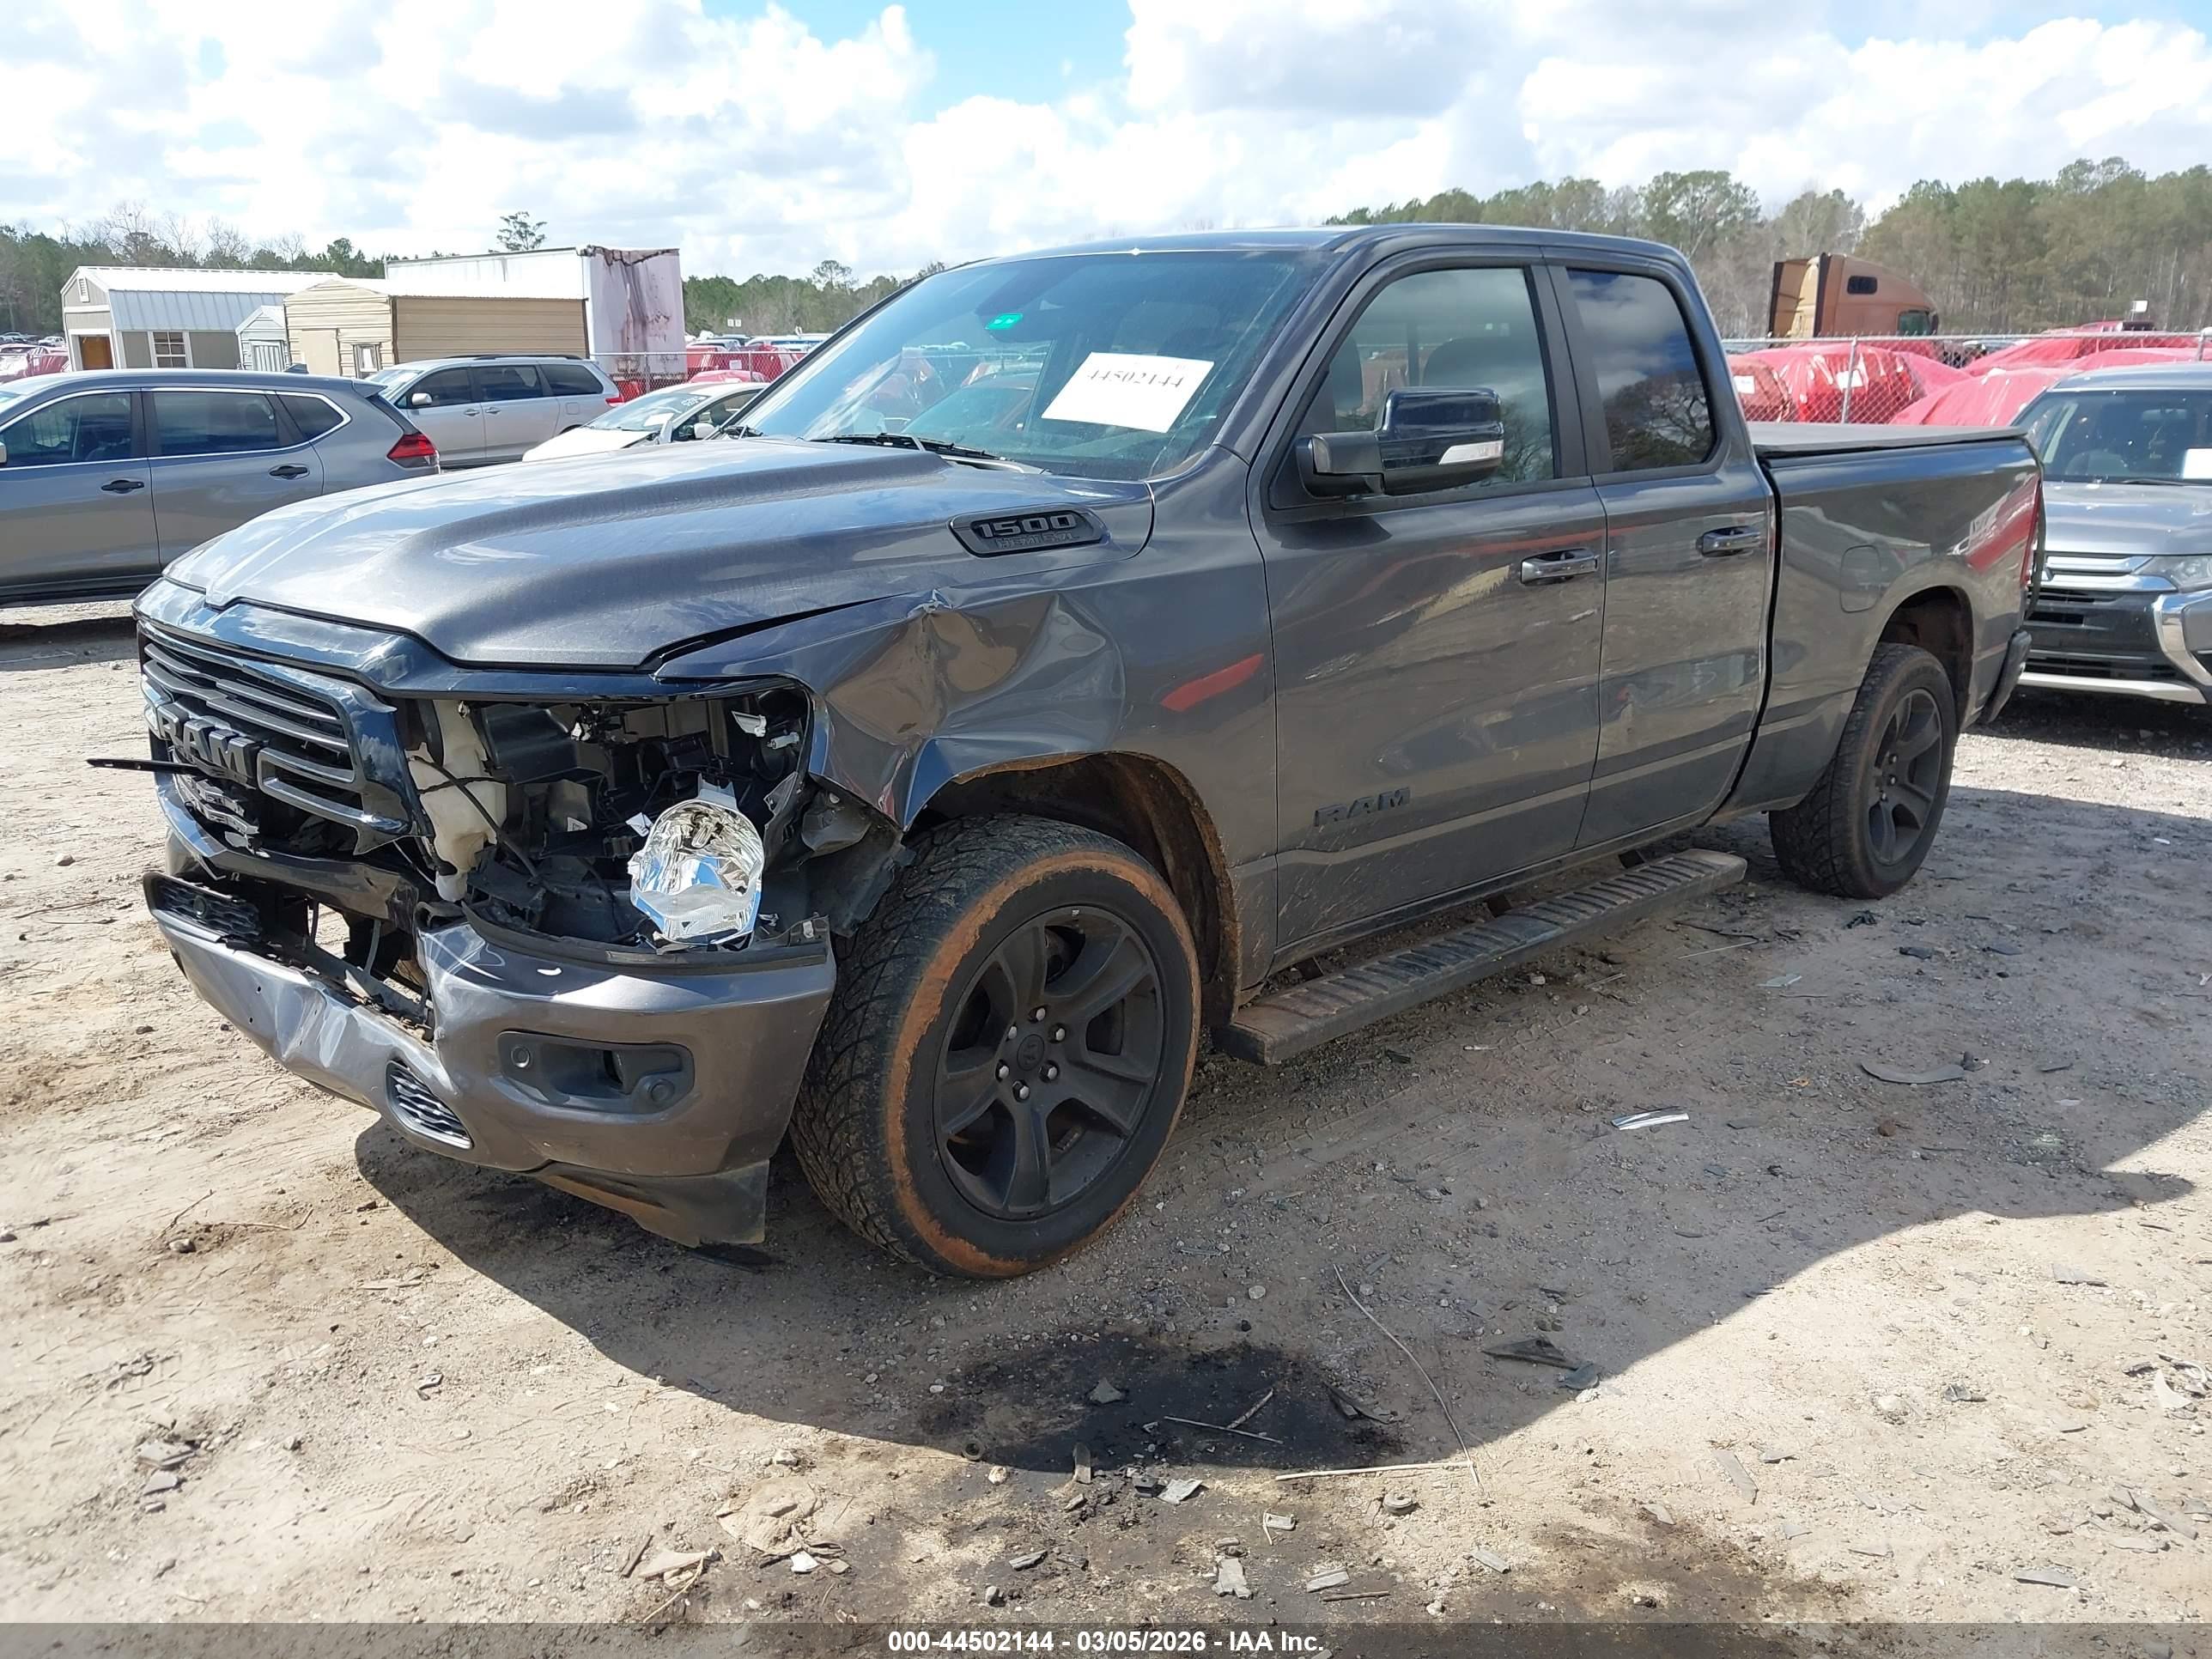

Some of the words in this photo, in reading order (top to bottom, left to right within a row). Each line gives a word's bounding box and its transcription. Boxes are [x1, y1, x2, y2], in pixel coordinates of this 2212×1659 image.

[979, 515, 1077, 538] 1500
[157, 702, 260, 789] RAM
[1314, 787, 1411, 827] RAM
